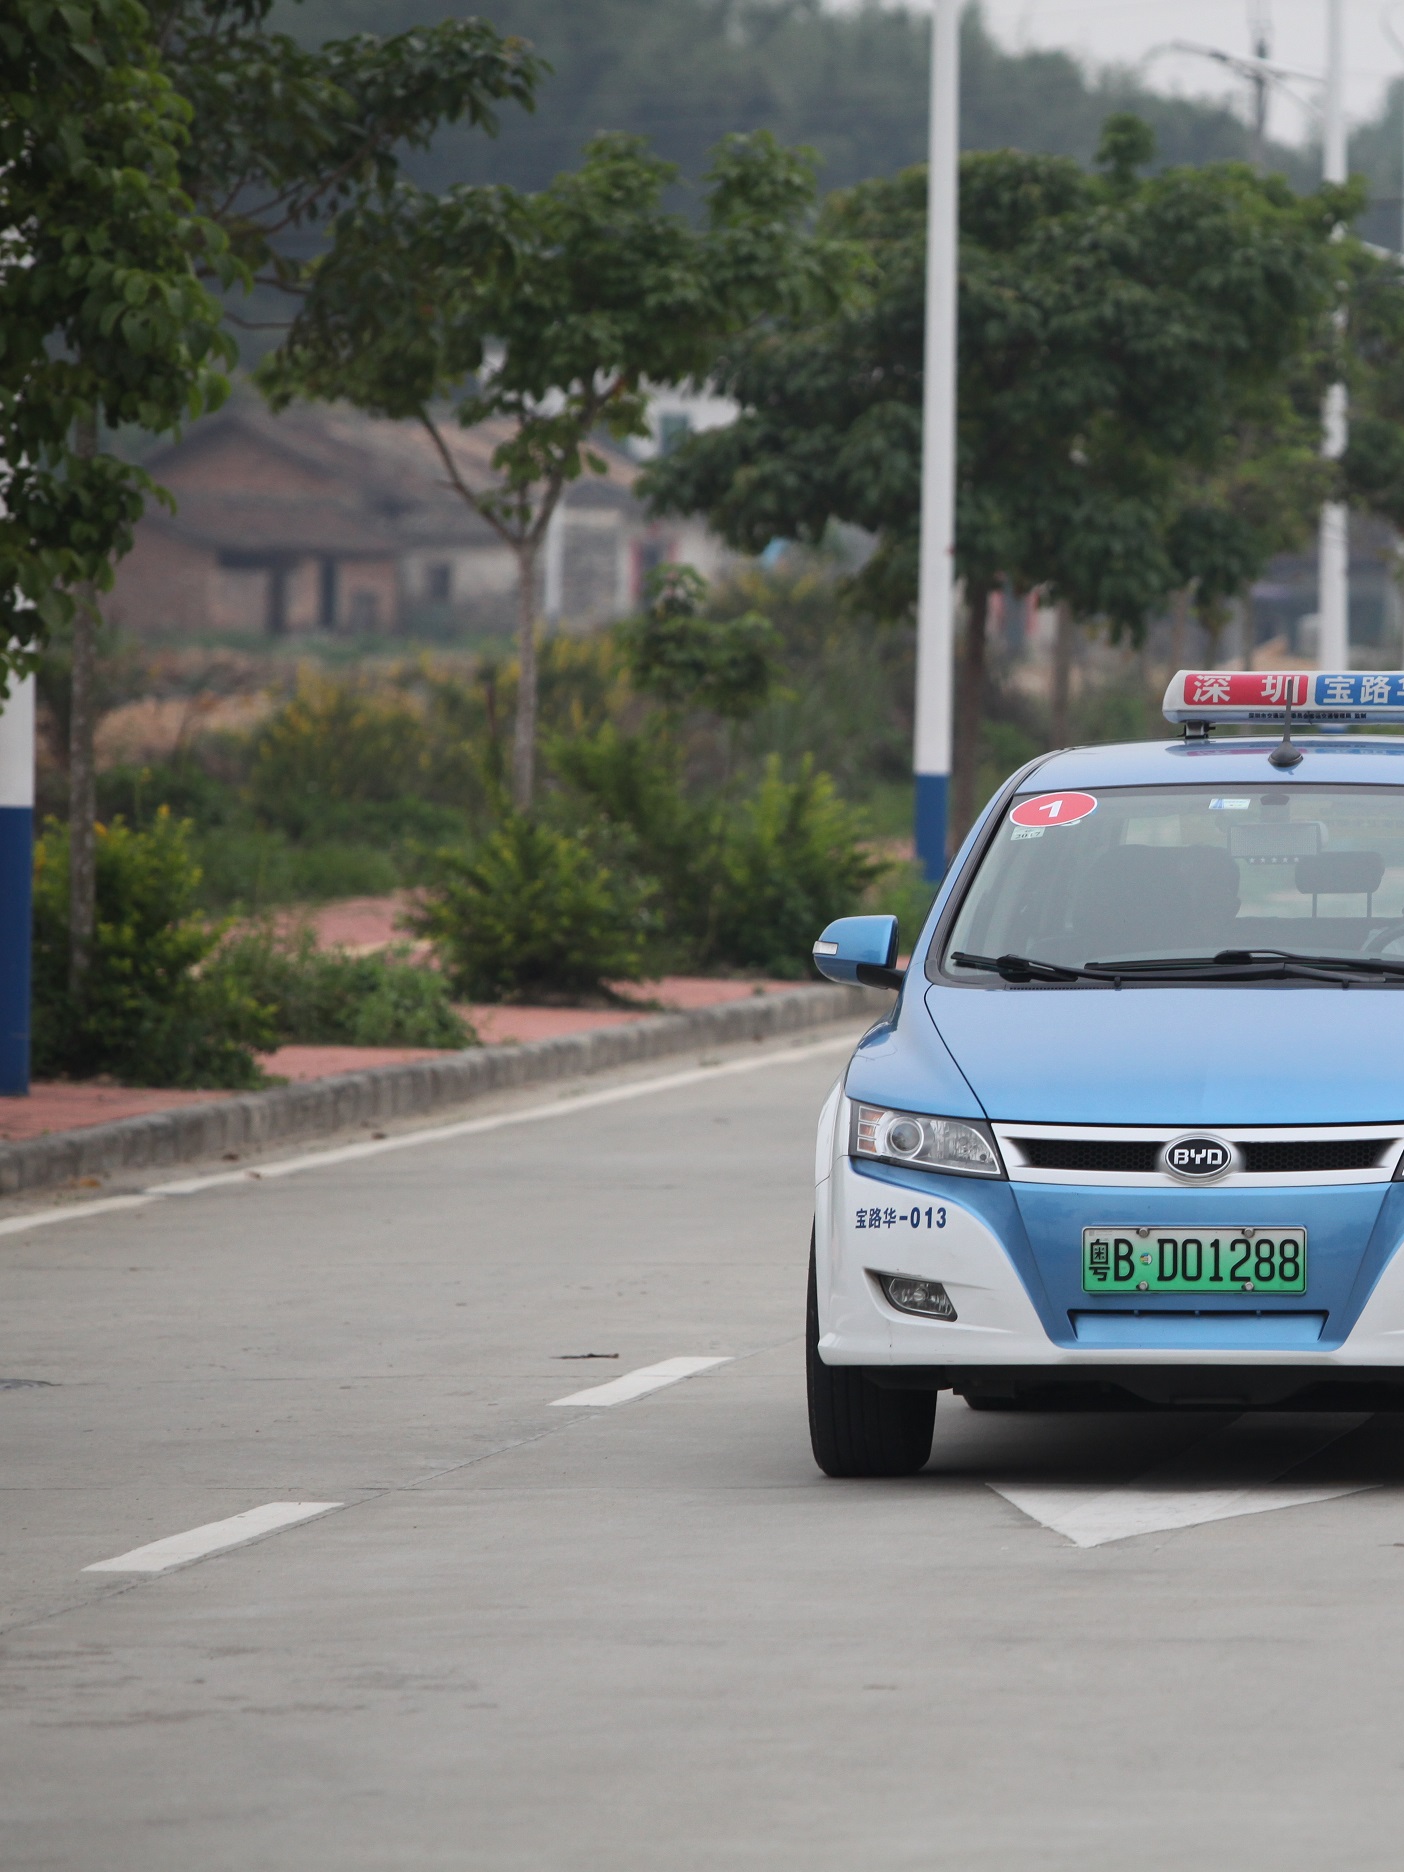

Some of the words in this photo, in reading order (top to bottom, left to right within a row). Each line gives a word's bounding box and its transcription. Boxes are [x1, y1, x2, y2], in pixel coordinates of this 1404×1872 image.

[1192, 675, 1299, 703] 深圳
[1039, 800, 1063, 818] 1
[1173, 1149, 1223, 1165] BYD
[855, 1207, 947, 1229] 宝路华-013
[1157, 1238, 1300, 1283] D01288
